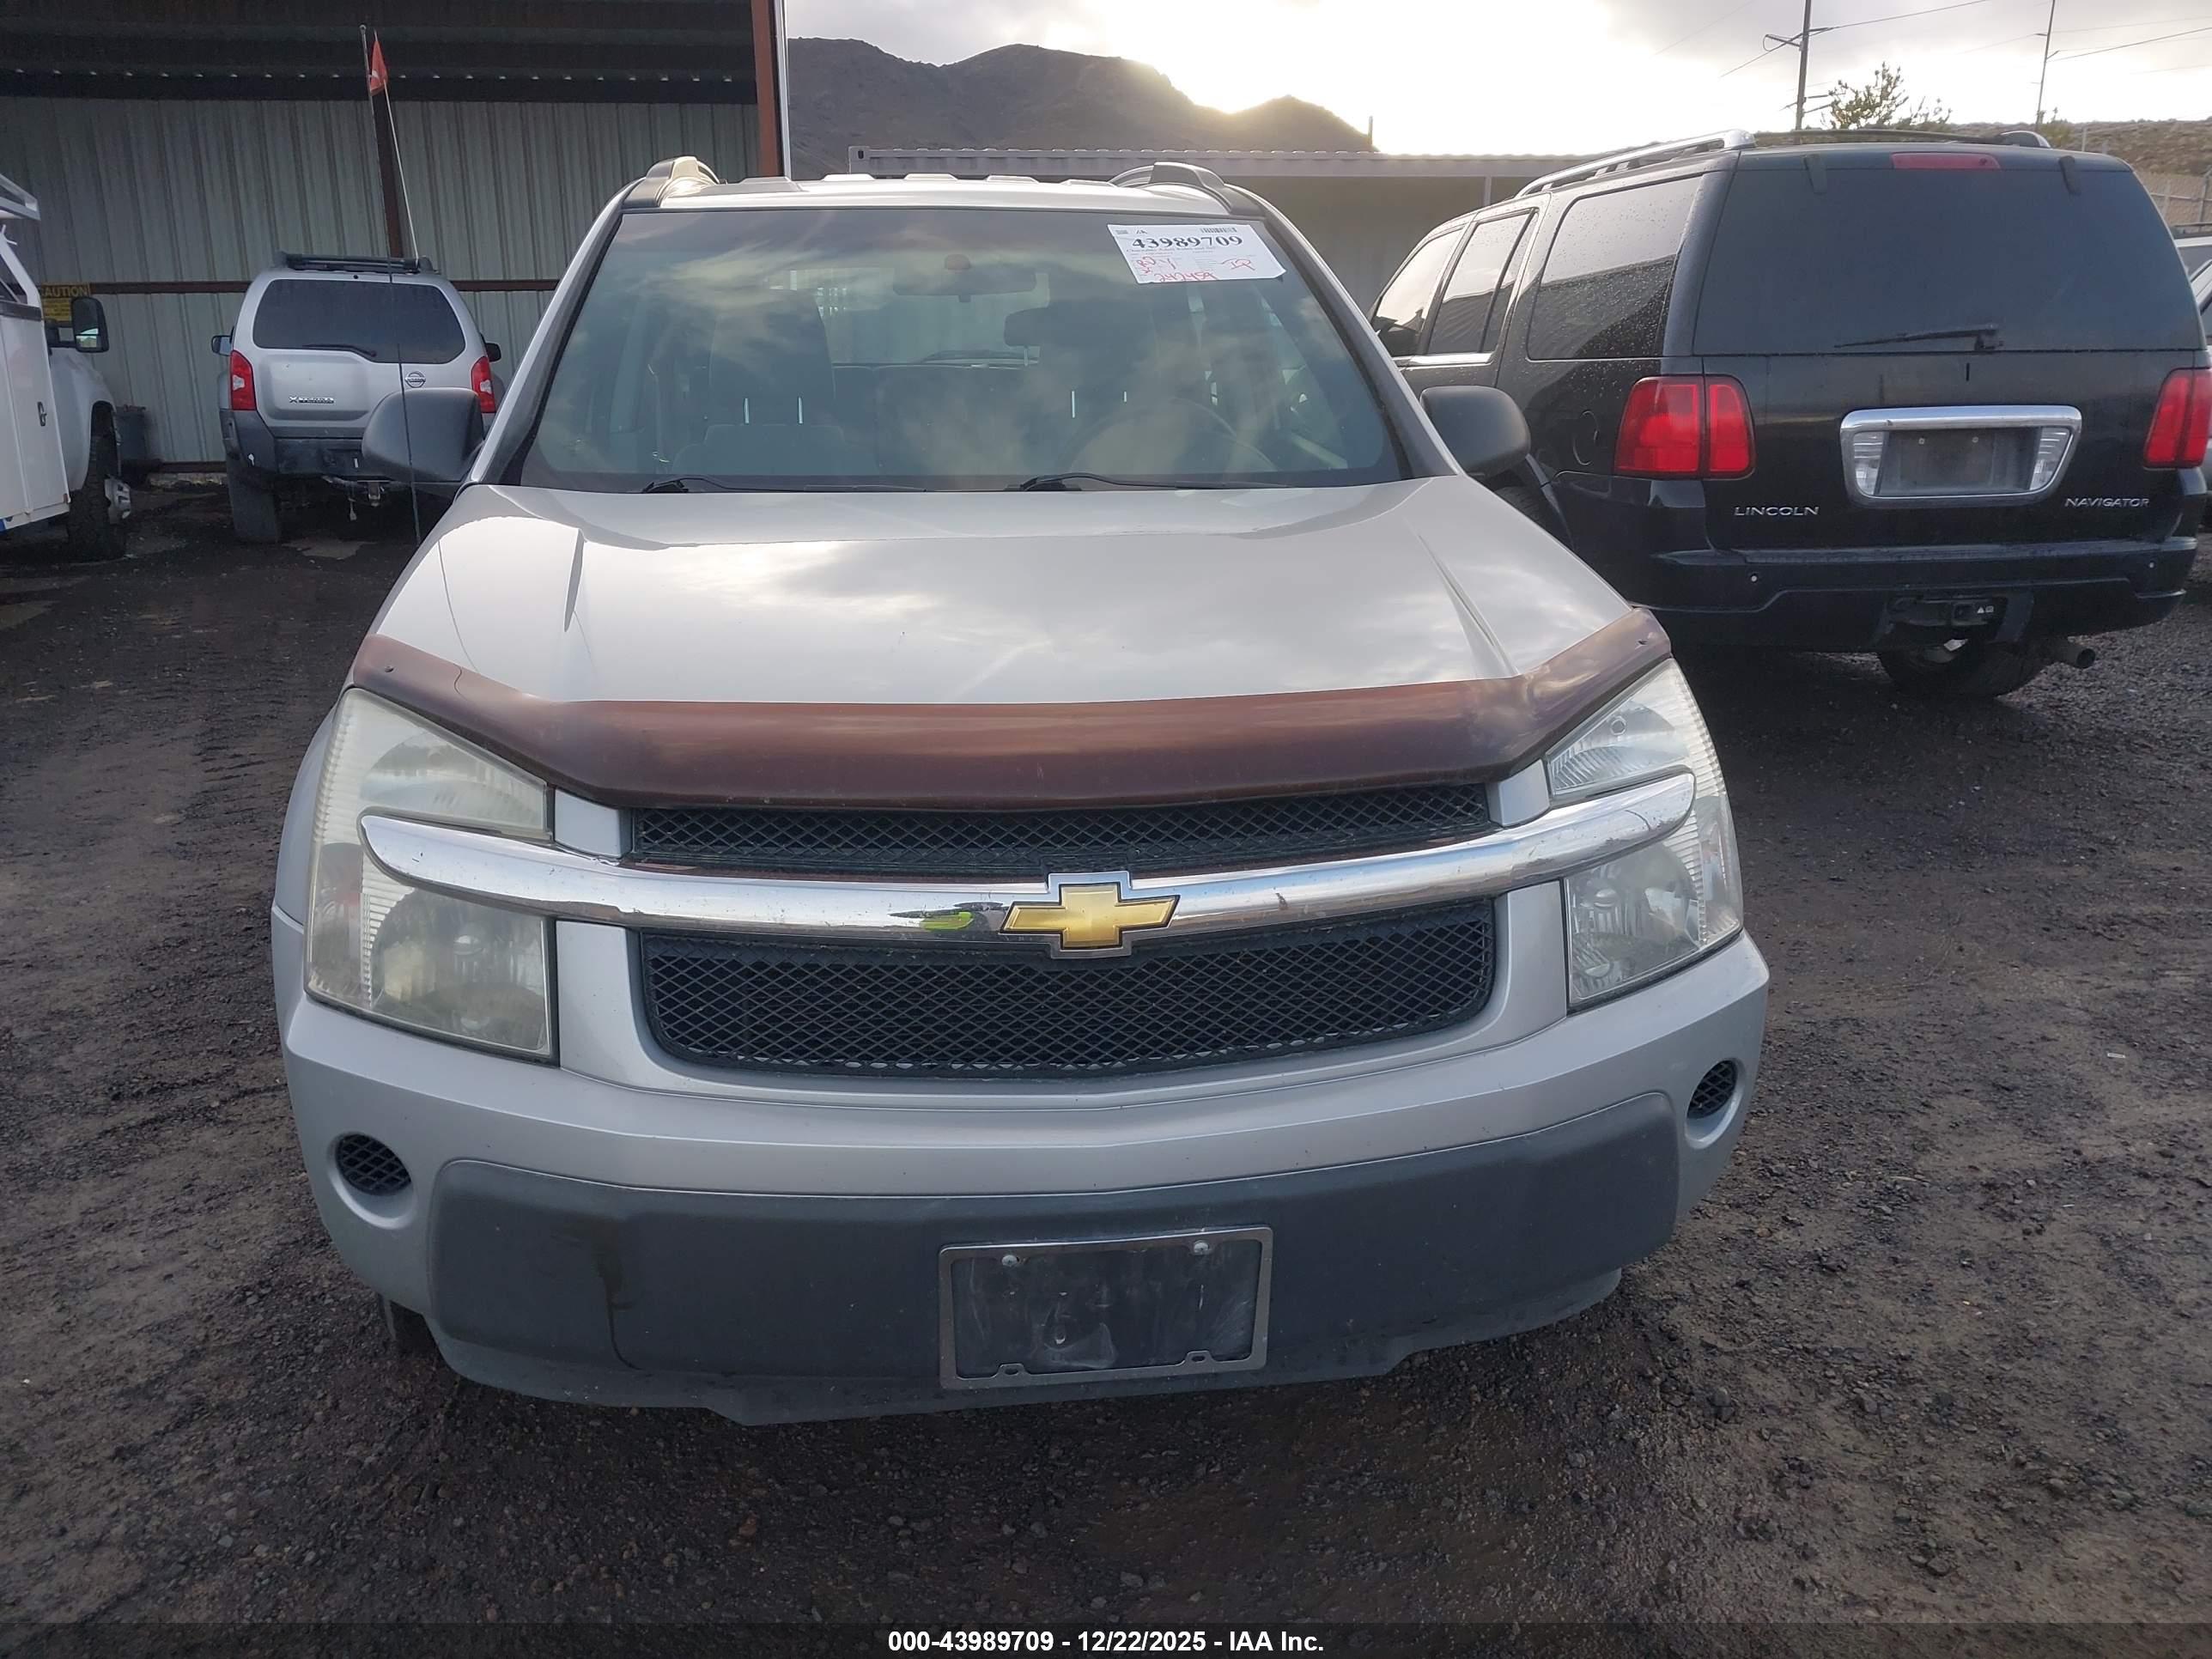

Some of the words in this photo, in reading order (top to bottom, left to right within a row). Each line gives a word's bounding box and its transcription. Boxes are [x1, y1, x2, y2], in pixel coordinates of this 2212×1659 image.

[1133, 236, 1243, 248] 43989709
[42, 286, 89, 297] AUTION
[2064, 498, 2150, 507] NAVIGATOR
[1735, 507, 1820, 516] LINCOLN
